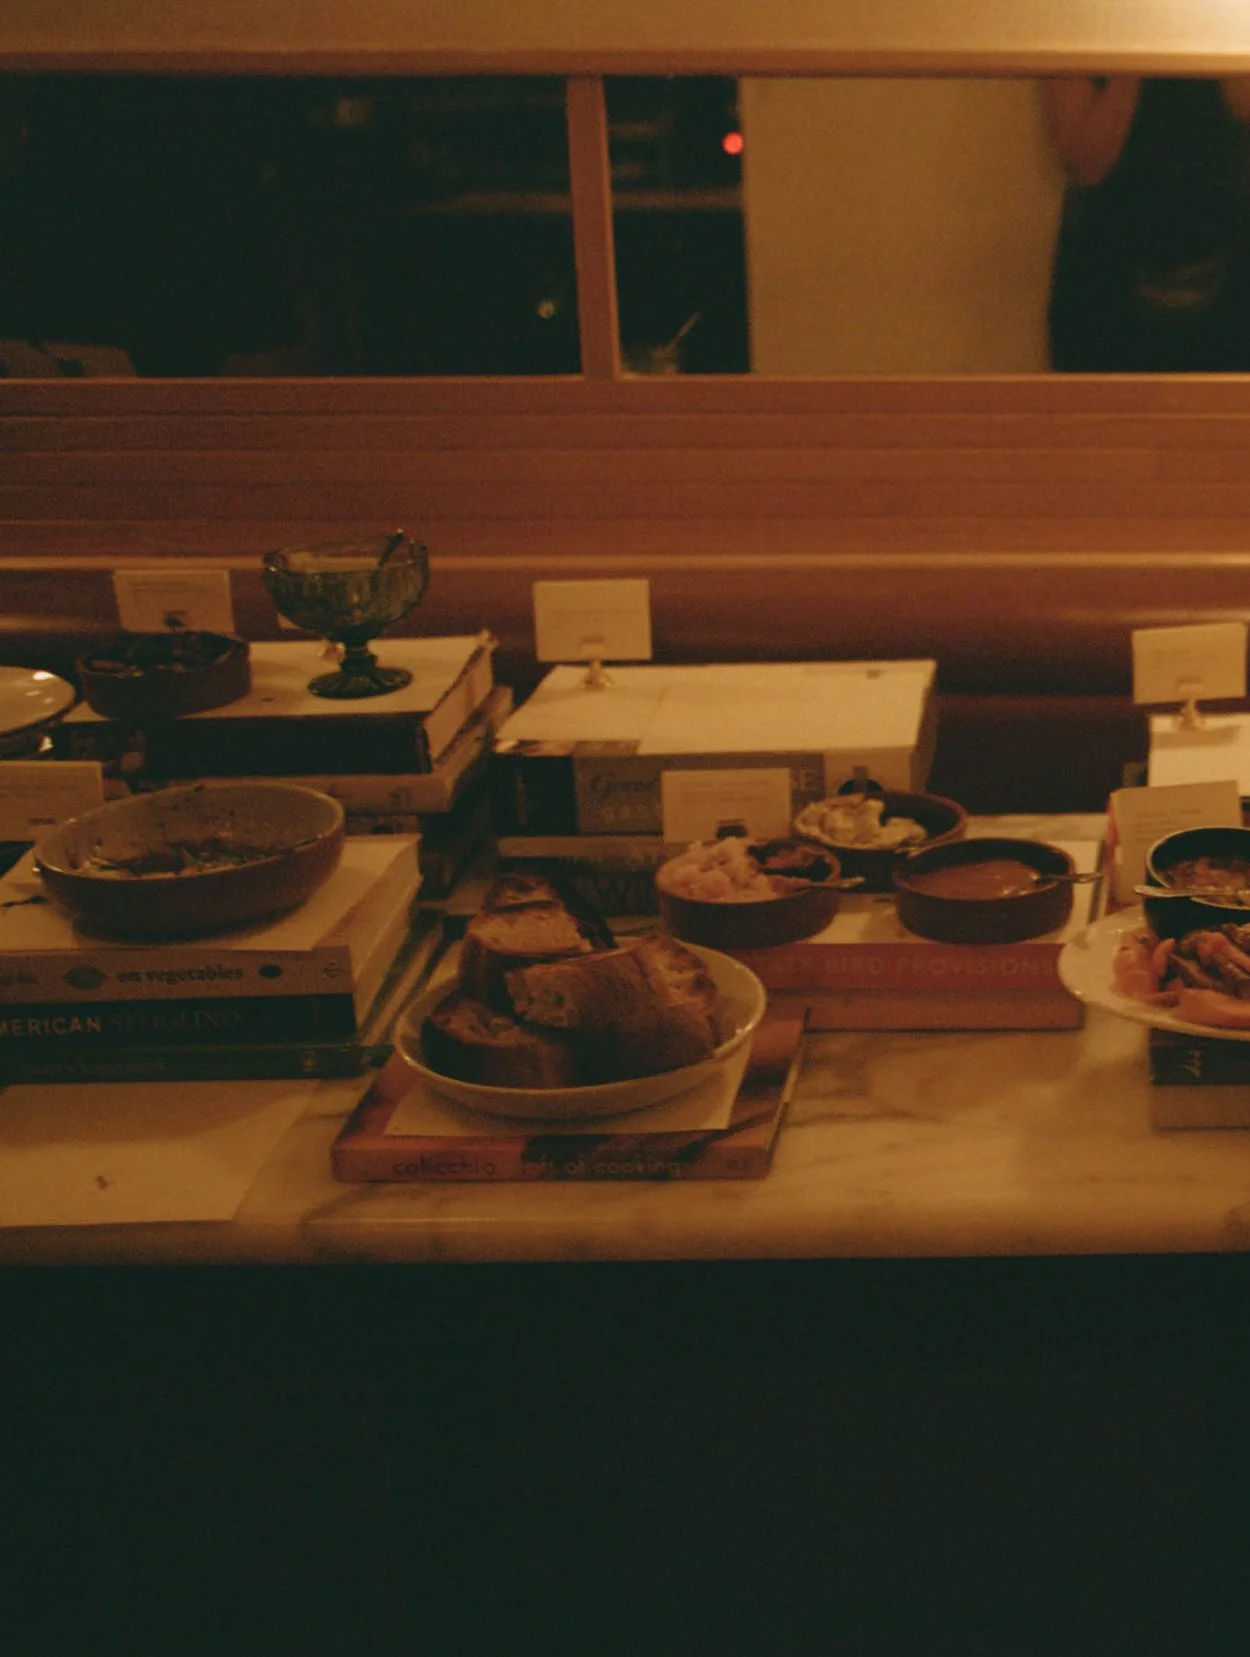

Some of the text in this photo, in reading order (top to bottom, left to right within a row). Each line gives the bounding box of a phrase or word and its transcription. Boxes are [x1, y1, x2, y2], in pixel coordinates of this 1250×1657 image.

[117, 964, 244, 985] on vegetables
[825, 958, 885, 976] BIRD
[897, 956, 1054, 977] PROVISIONS
[0, 1015, 102, 1038] MERICAN
[593, 1153, 682, 1179] cooking
